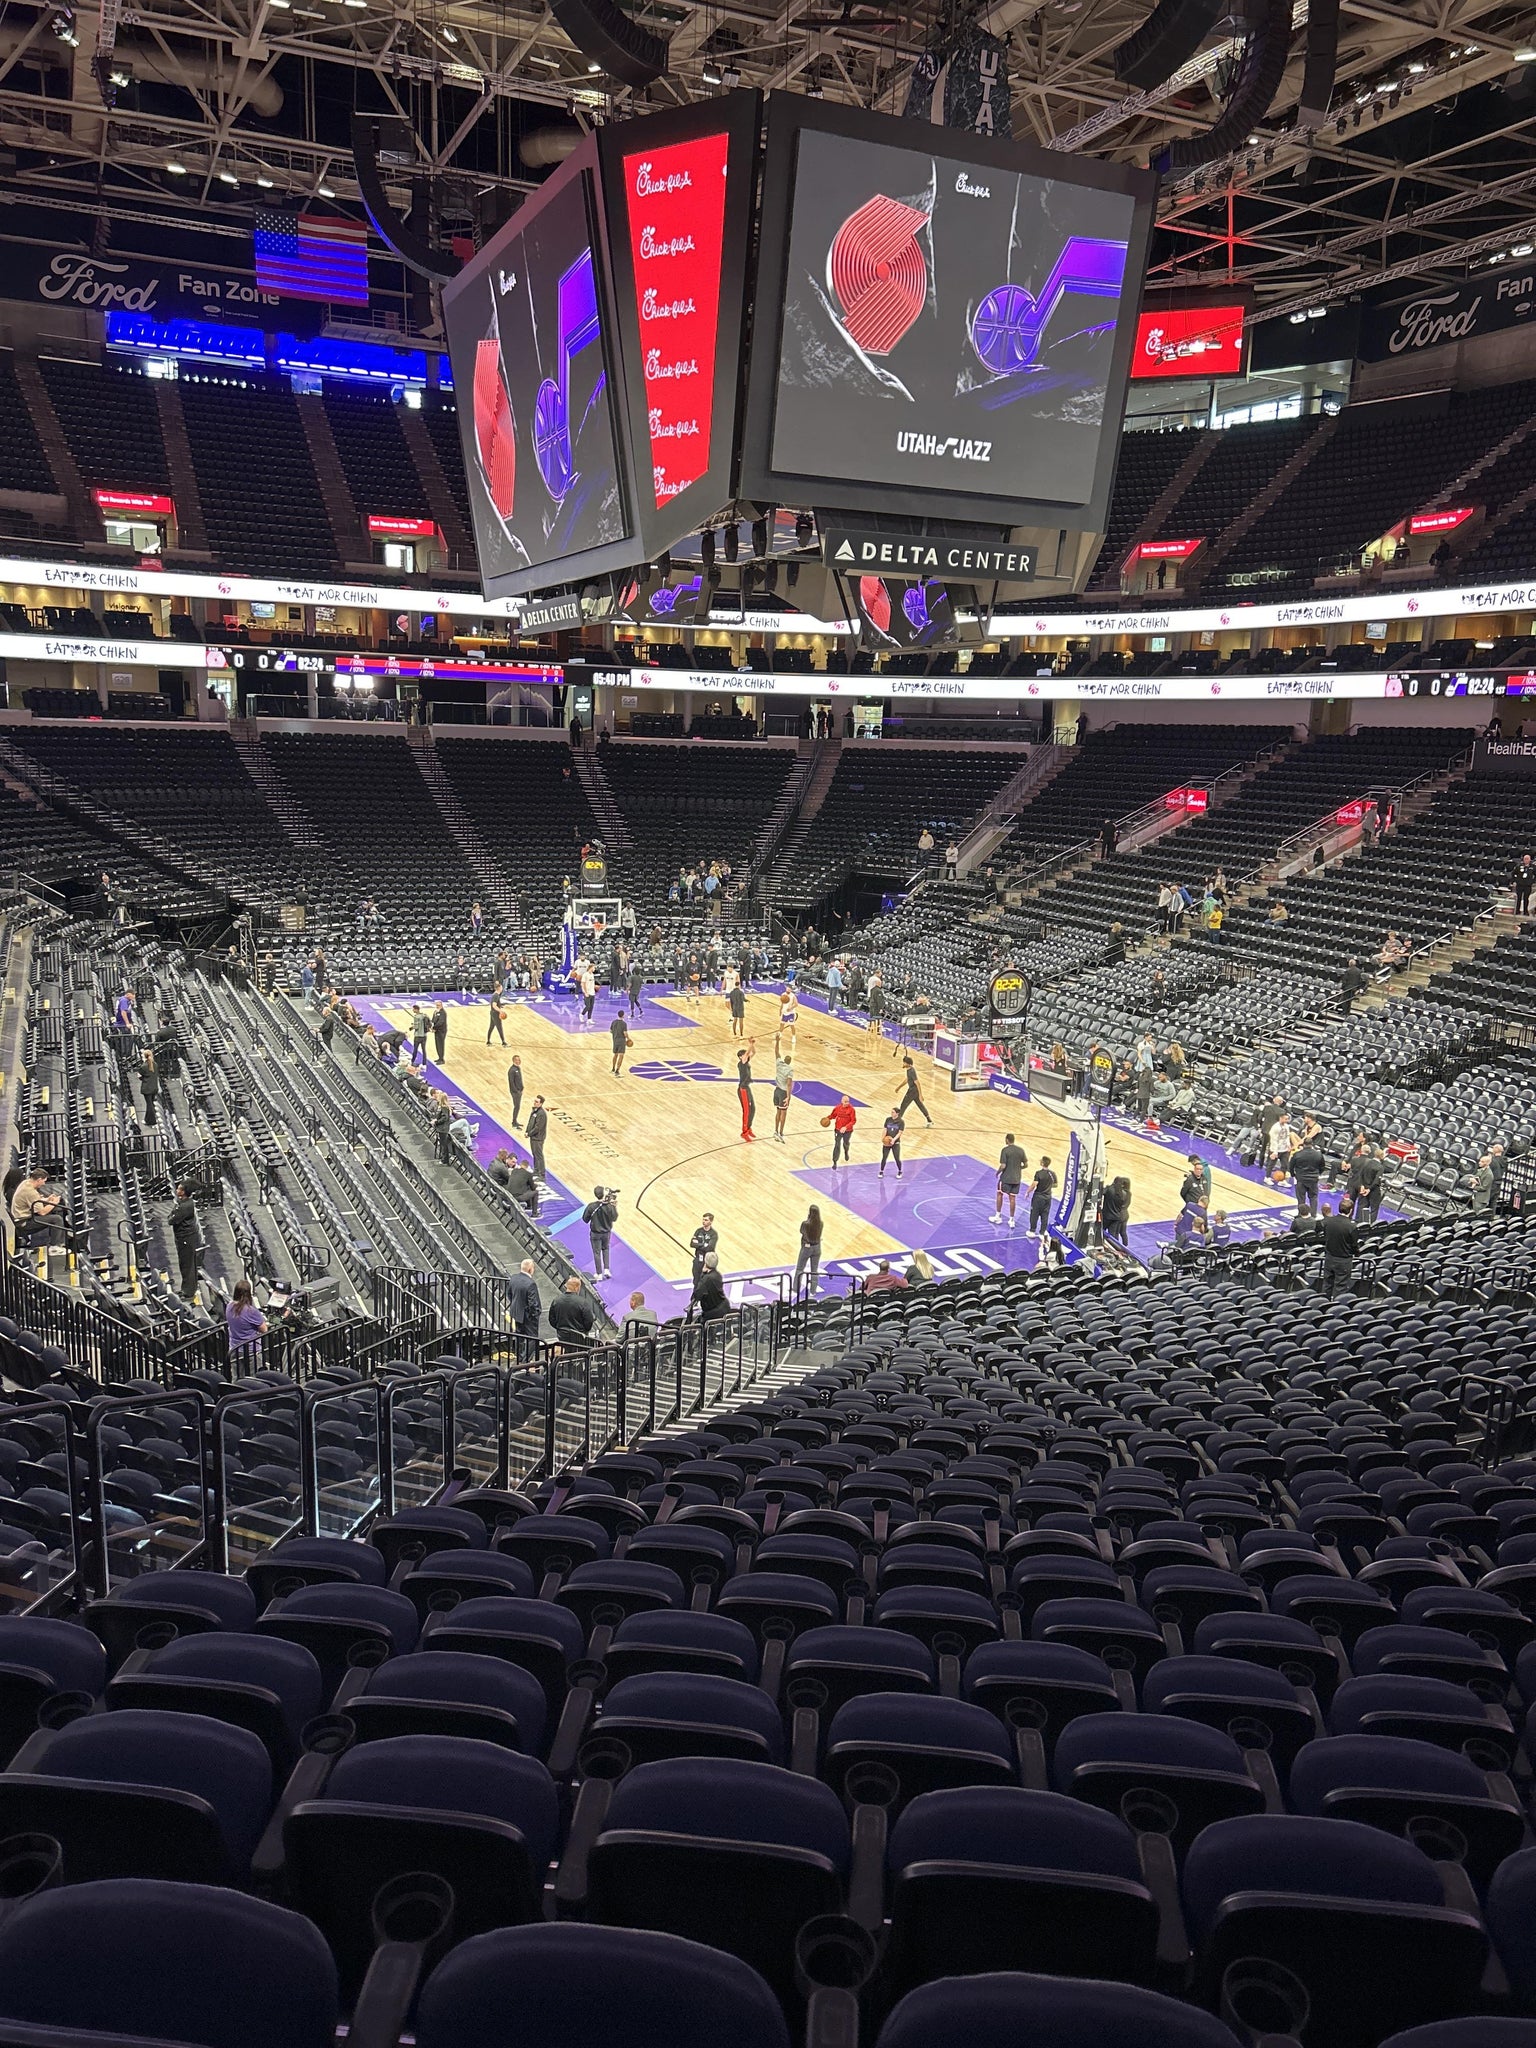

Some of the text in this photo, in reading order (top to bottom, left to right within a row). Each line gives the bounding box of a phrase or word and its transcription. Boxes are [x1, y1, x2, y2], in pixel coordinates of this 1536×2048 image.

[975, 50, 999, 136] UTA
[636, 166, 692, 197] Chick-fil-A
[640, 230, 695, 259] Chick-fil-A
[39, 254, 159, 312] Ford
[178, 274, 221, 298] Fan
[1496, 277, 1534, 300] Fan
[642, 292, 696, 320] Chick-fil-A
[1389, 291, 1482, 353] Ford
[645, 353, 699, 380] Chick-fil-A
[897, 431, 992, 461] UTAH JAZZ
[861, 542, 1030, 572] DELTA CENTER
[45, 569, 66, 582] EAT
[317, 588, 340, 601] MOR
[1500, 589, 1525, 605] MOR
[109, 603, 141, 613] visionary
[527, 603, 578, 626] DELTA CENTER
[1277, 609, 1295, 621] EAT
[1118, 617, 1138, 630] MOR
[46, 643, 66, 655] EAT
[234, 653, 244, 668] 0
[258, 655, 269, 669] 0
[593, 672, 631, 686] 05:40 PM
[722, 677, 742, 688] MOR
[892, 681, 909, 693] EAT
[1409, 679, 1419, 696] 0
[1430, 679, 1441, 696] 0
[1110, 683, 1130, 695] MOR
[1267, 682, 1284, 694] EAT
[996, 977, 1023, 991] 82:24
[552, 1112, 585, 1133] DELTA
[580, 1133, 620, 1158] CENTER
[1059, 1180, 1073, 1220] AMERICA
